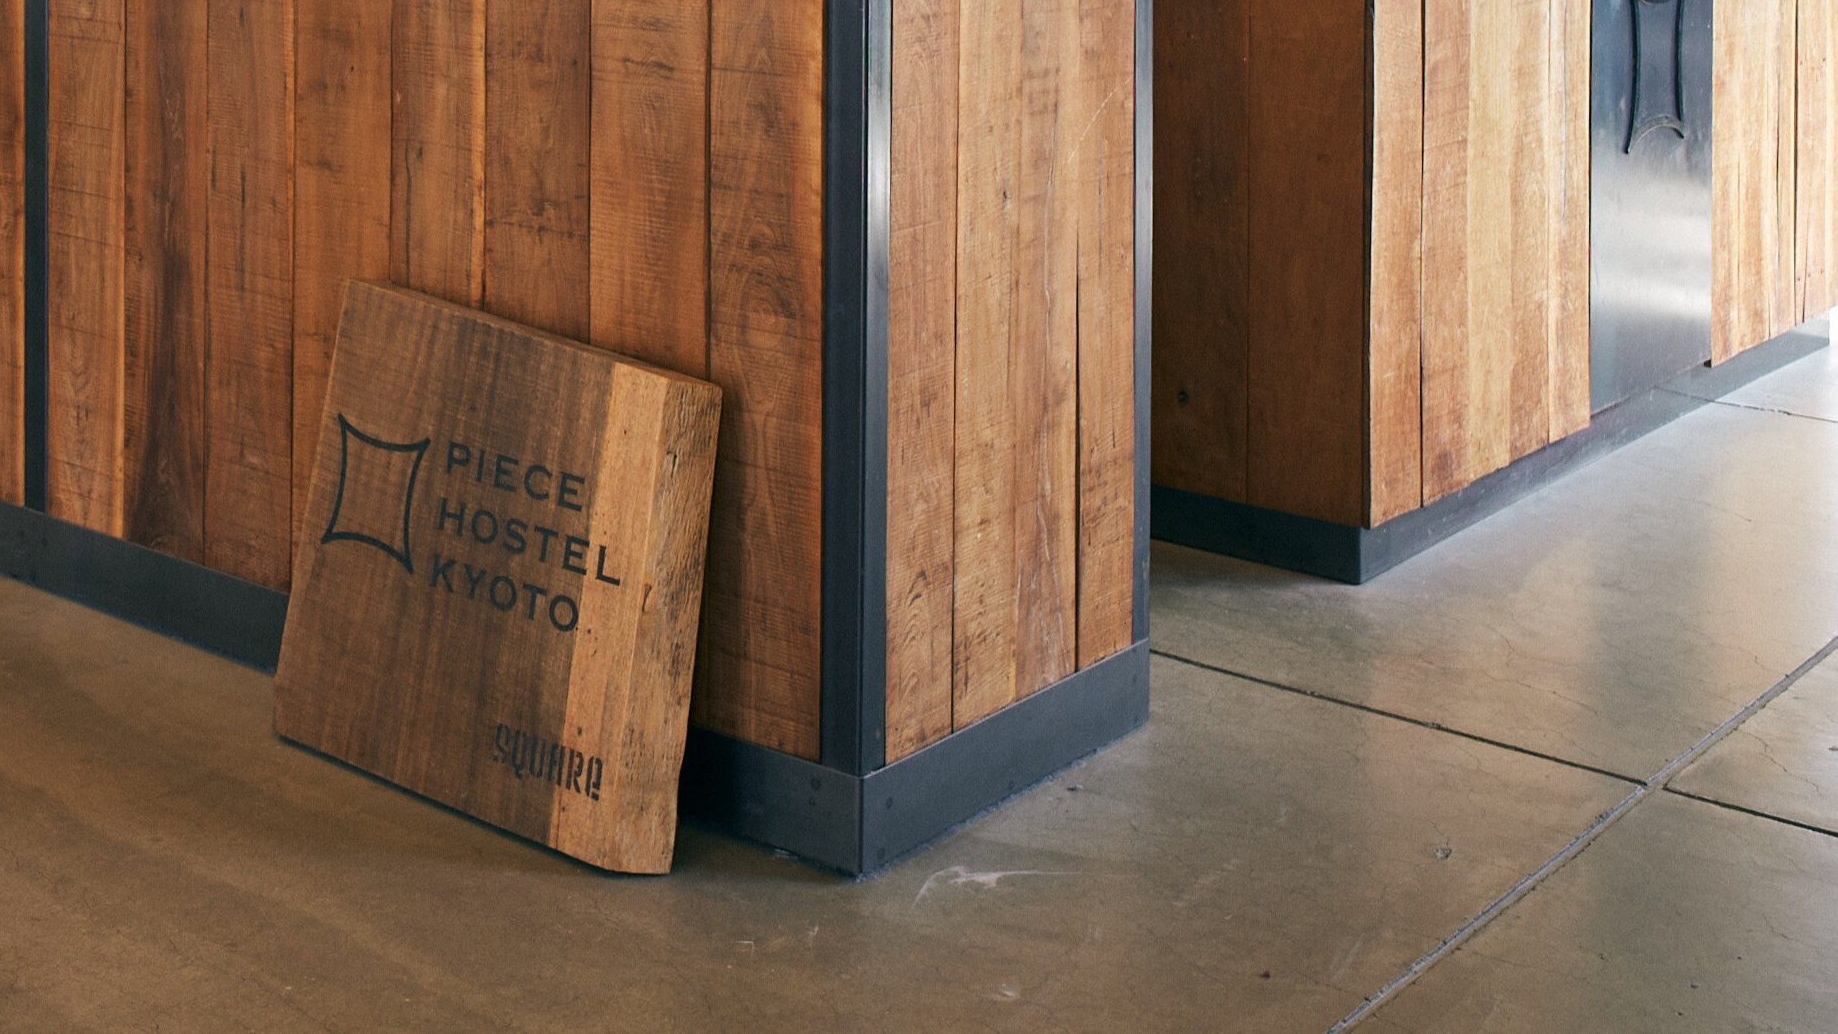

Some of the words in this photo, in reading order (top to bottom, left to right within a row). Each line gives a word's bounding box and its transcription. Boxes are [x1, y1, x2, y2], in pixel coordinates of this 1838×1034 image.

[446, 440, 586, 512] PIECE
[437, 497, 621, 586] HOSTEL
[429, 553, 579, 632] KYOTO
